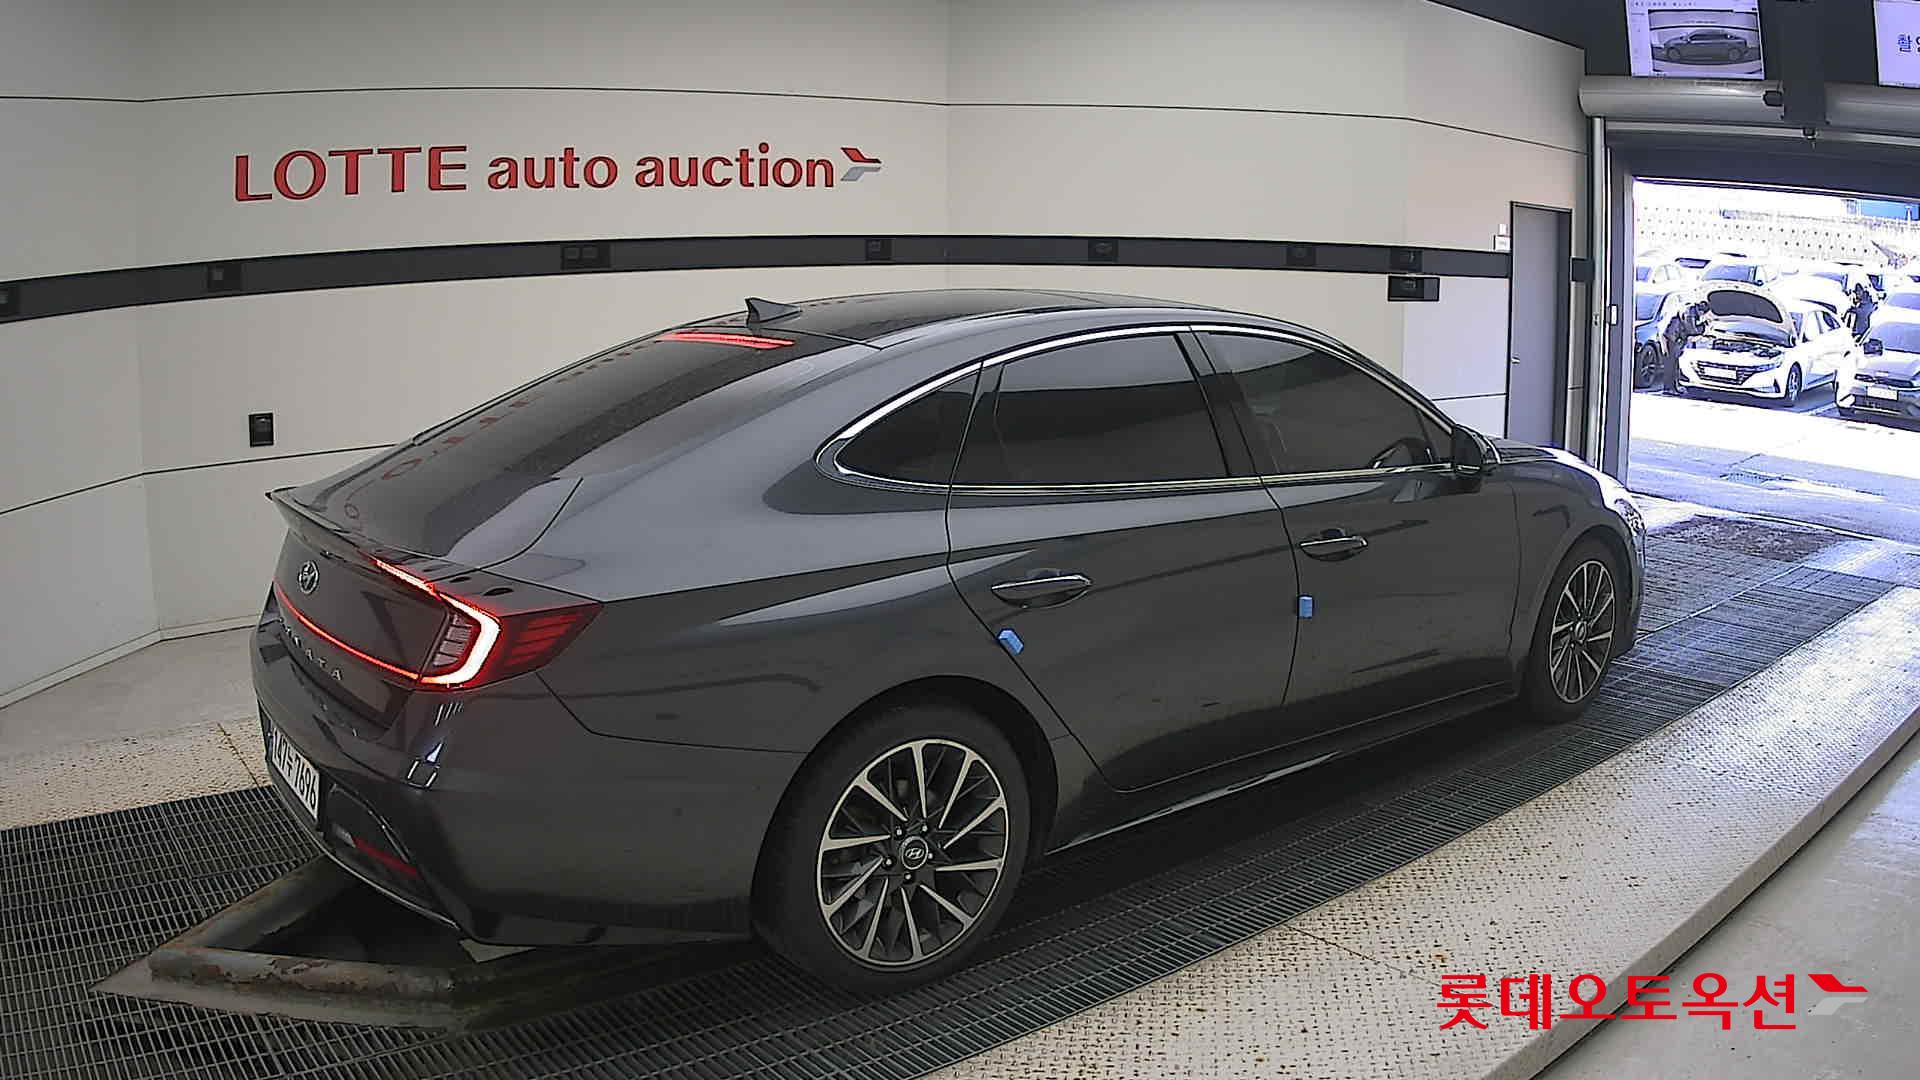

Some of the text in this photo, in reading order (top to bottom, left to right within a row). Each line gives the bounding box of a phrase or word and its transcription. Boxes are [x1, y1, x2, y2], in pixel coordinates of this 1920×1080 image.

[235, 142, 834, 201] LOTTE auto auction
